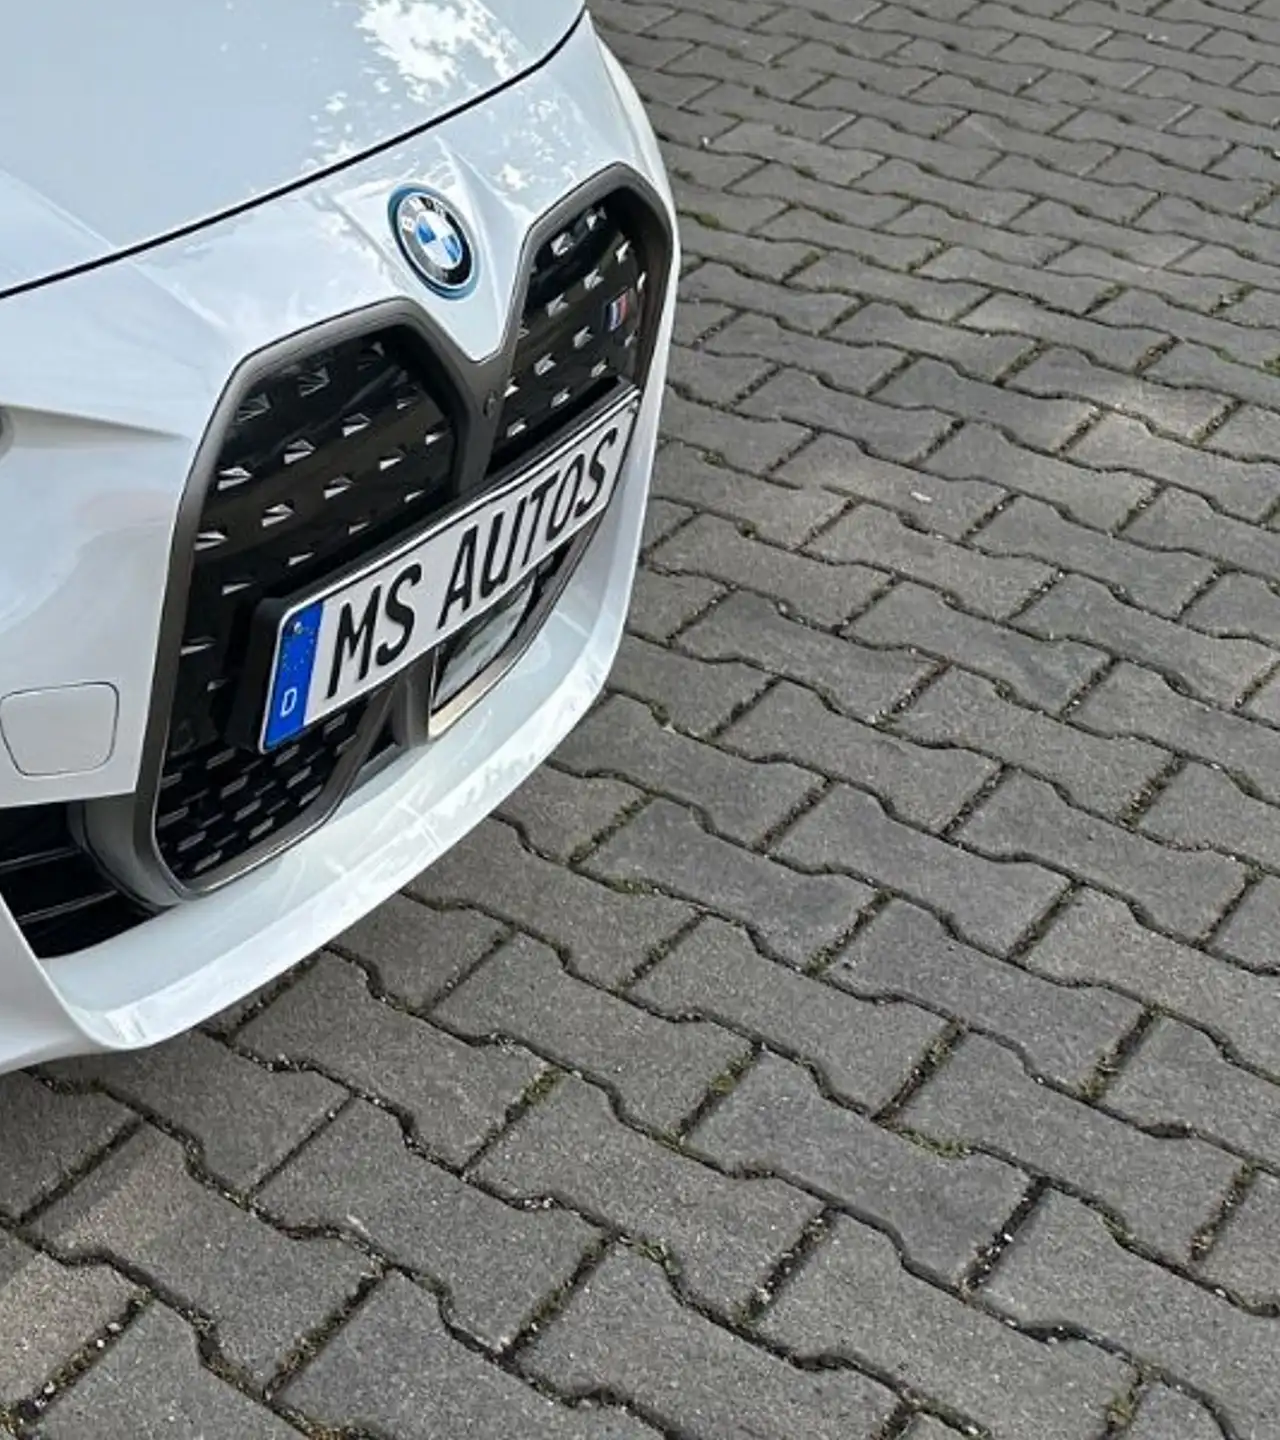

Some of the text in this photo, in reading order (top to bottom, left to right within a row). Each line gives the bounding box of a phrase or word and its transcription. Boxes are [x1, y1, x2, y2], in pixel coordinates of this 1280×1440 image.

[278, 426, 619, 719] D MS AUTOS
